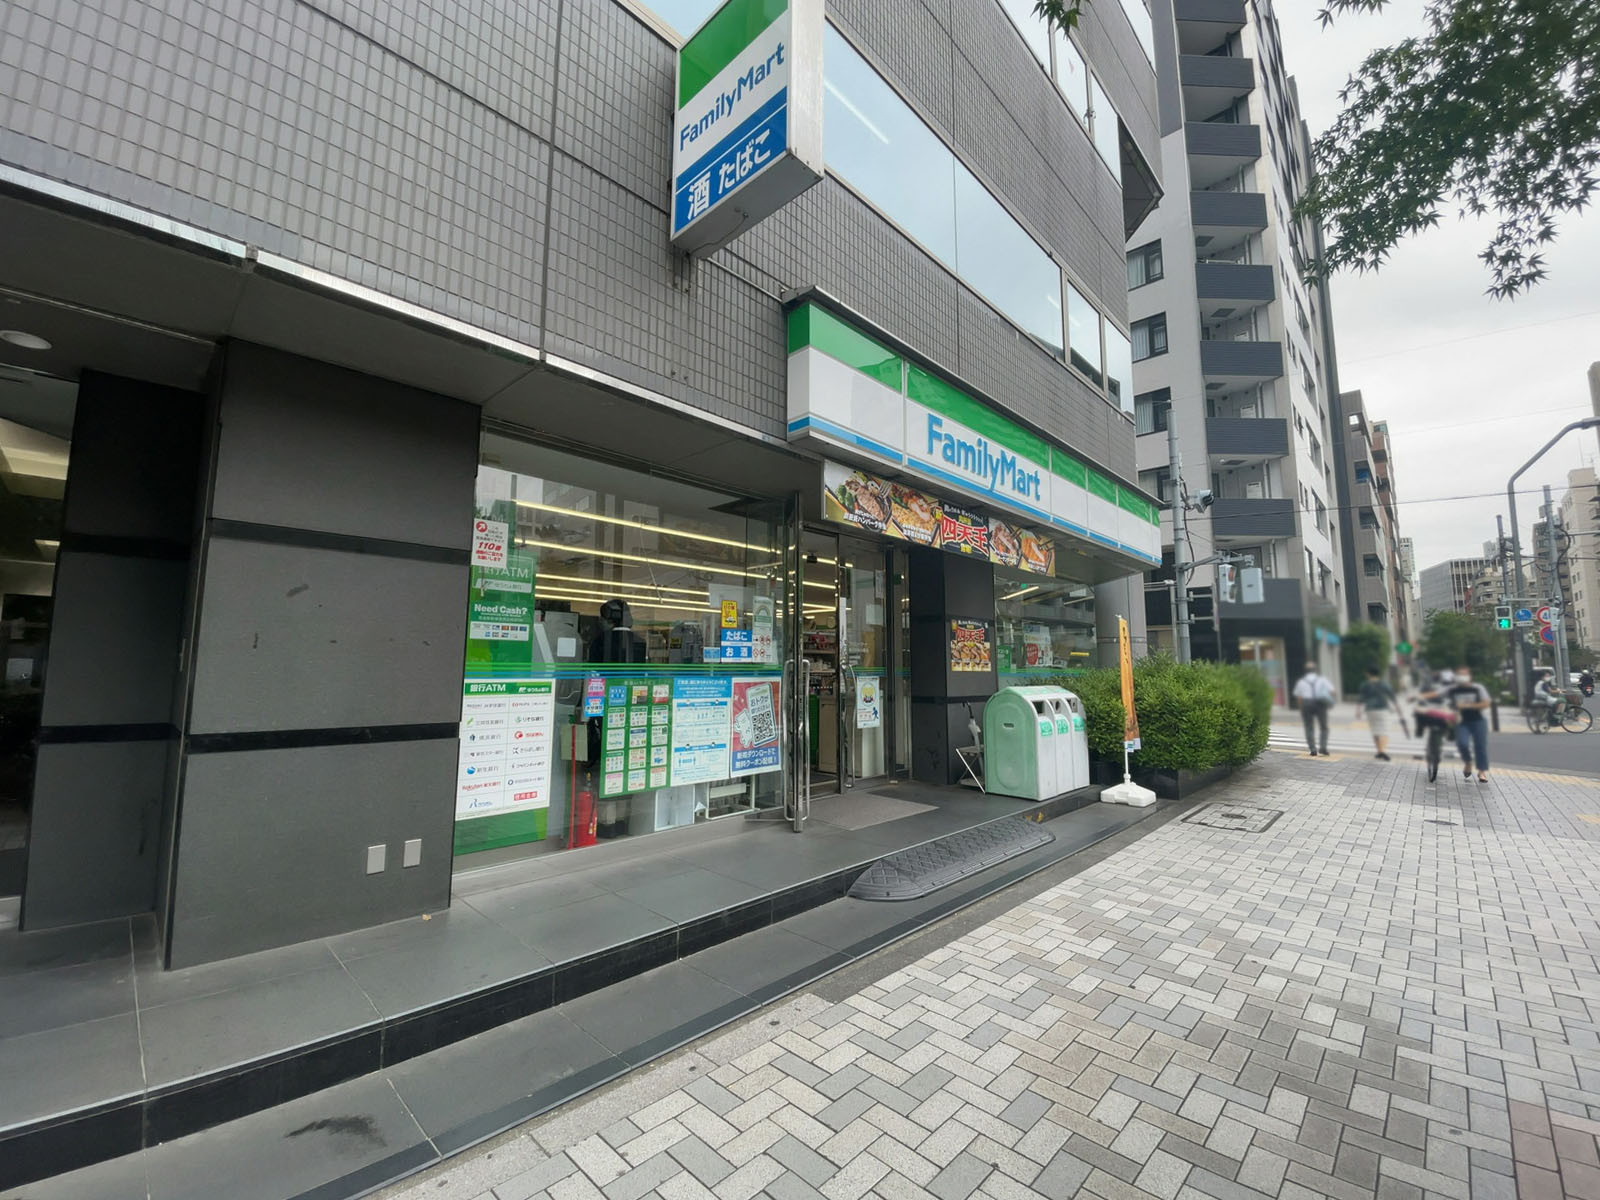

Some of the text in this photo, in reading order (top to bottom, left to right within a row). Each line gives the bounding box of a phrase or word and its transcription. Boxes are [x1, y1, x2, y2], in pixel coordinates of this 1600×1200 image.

[679, 41, 785, 153] FamilyMart
[687, 128, 771, 221] 酒 たばこ
[926, 412, 1041, 502] FamilyMart
[941, 513, 990, 557] 四天王
[474, 604, 527, 615] Need Cash?
[726, 631, 748, 641] たばこ
[726, 647, 748, 657] お酒
[470, 684, 506, 692] 銀行ATM
